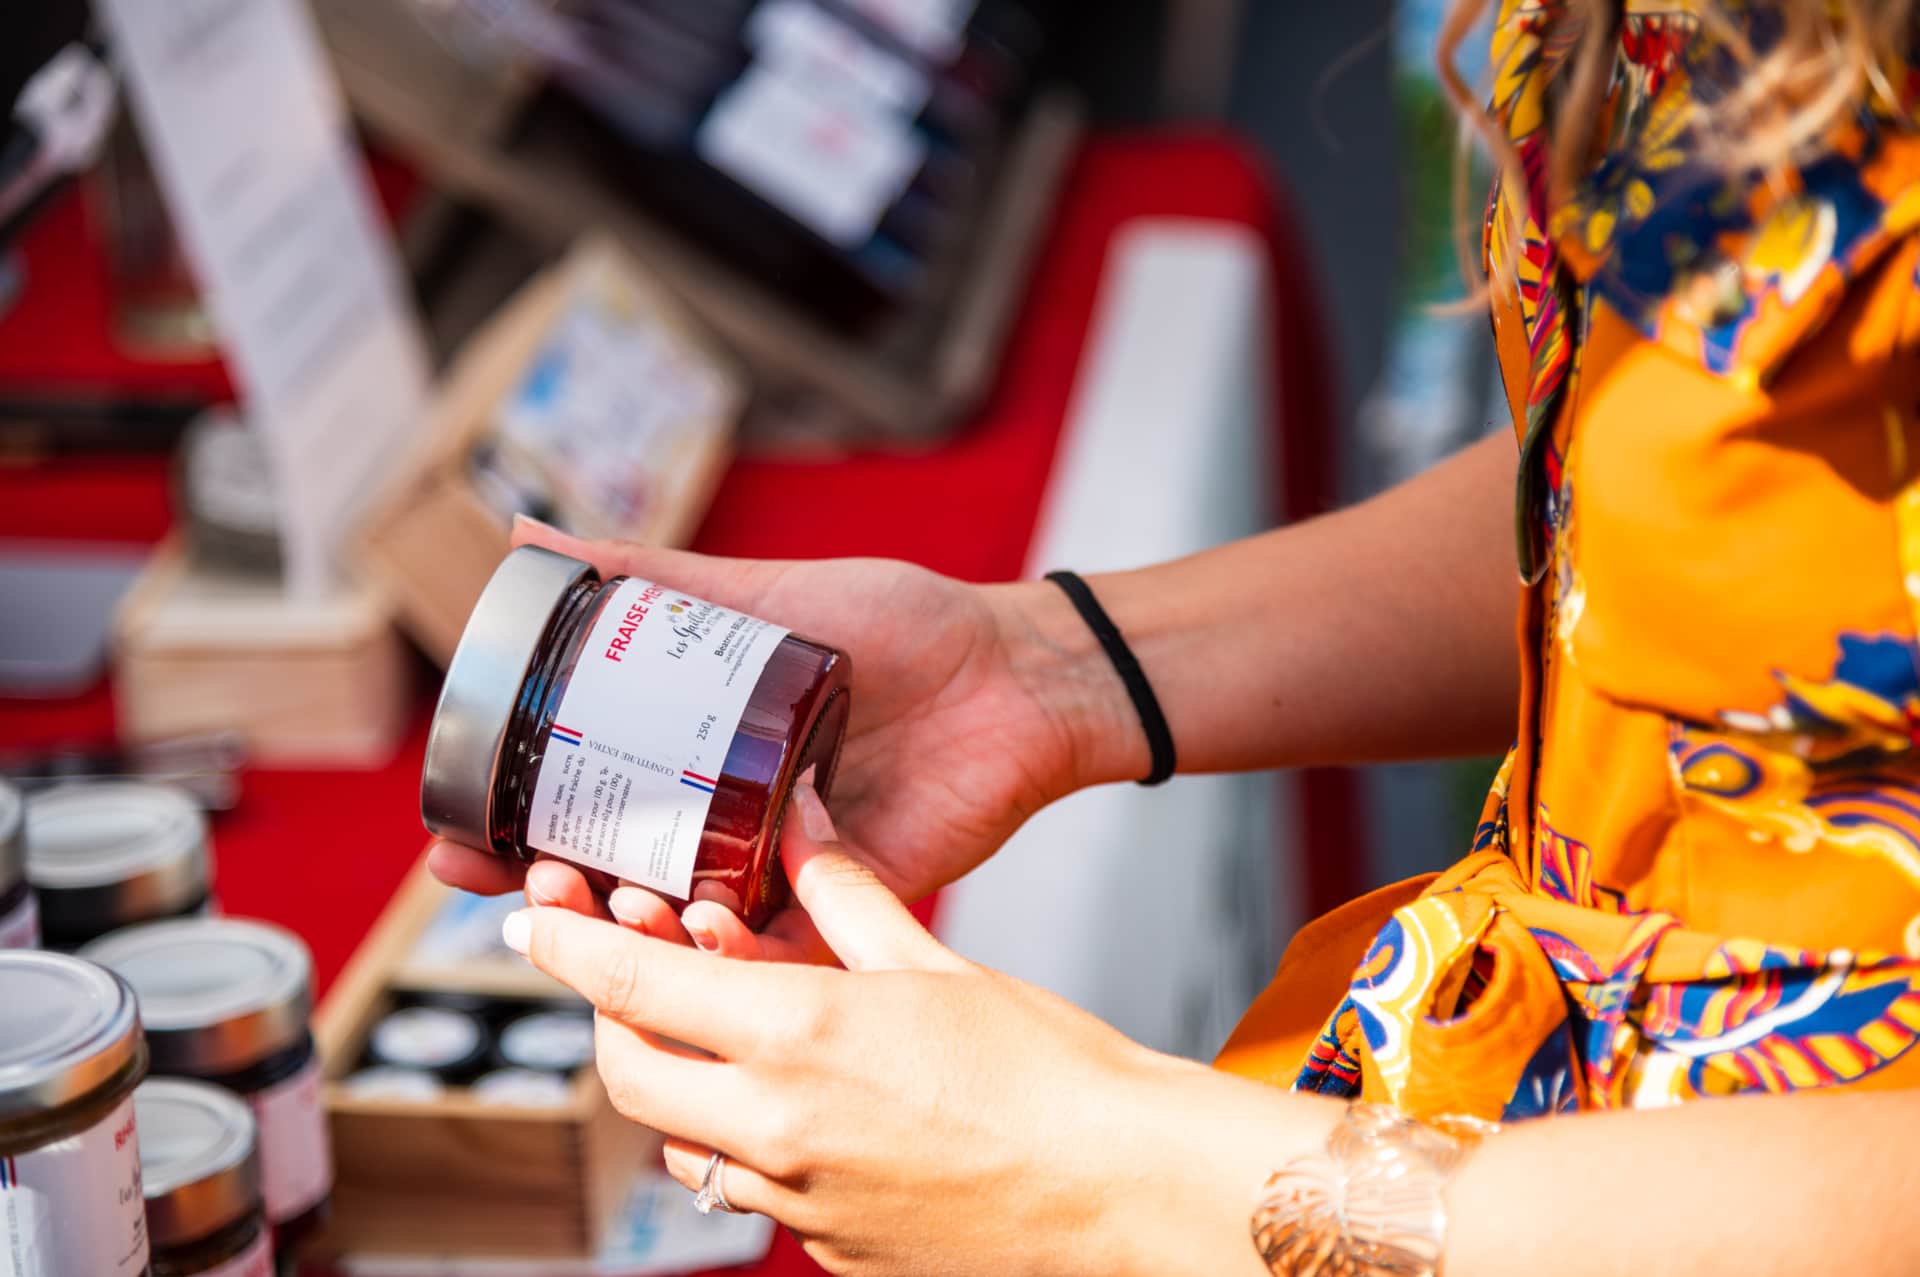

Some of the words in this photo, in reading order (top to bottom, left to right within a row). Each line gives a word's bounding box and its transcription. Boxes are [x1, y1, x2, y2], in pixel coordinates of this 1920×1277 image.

[605, 604, 647, 662] FRAISE
[666, 641, 688, 659] Les
[696, 721, 710, 740] 250
[706, 714, 716, 722] g
[589, 739, 619, 757] EXTRA
[577, 756, 585, 767] du
[620, 752, 673, 776] CONFITURE
[593, 785, 603, 798] 100
[605, 791, 614, 809] pour
[590, 800, 598, 817] pour
